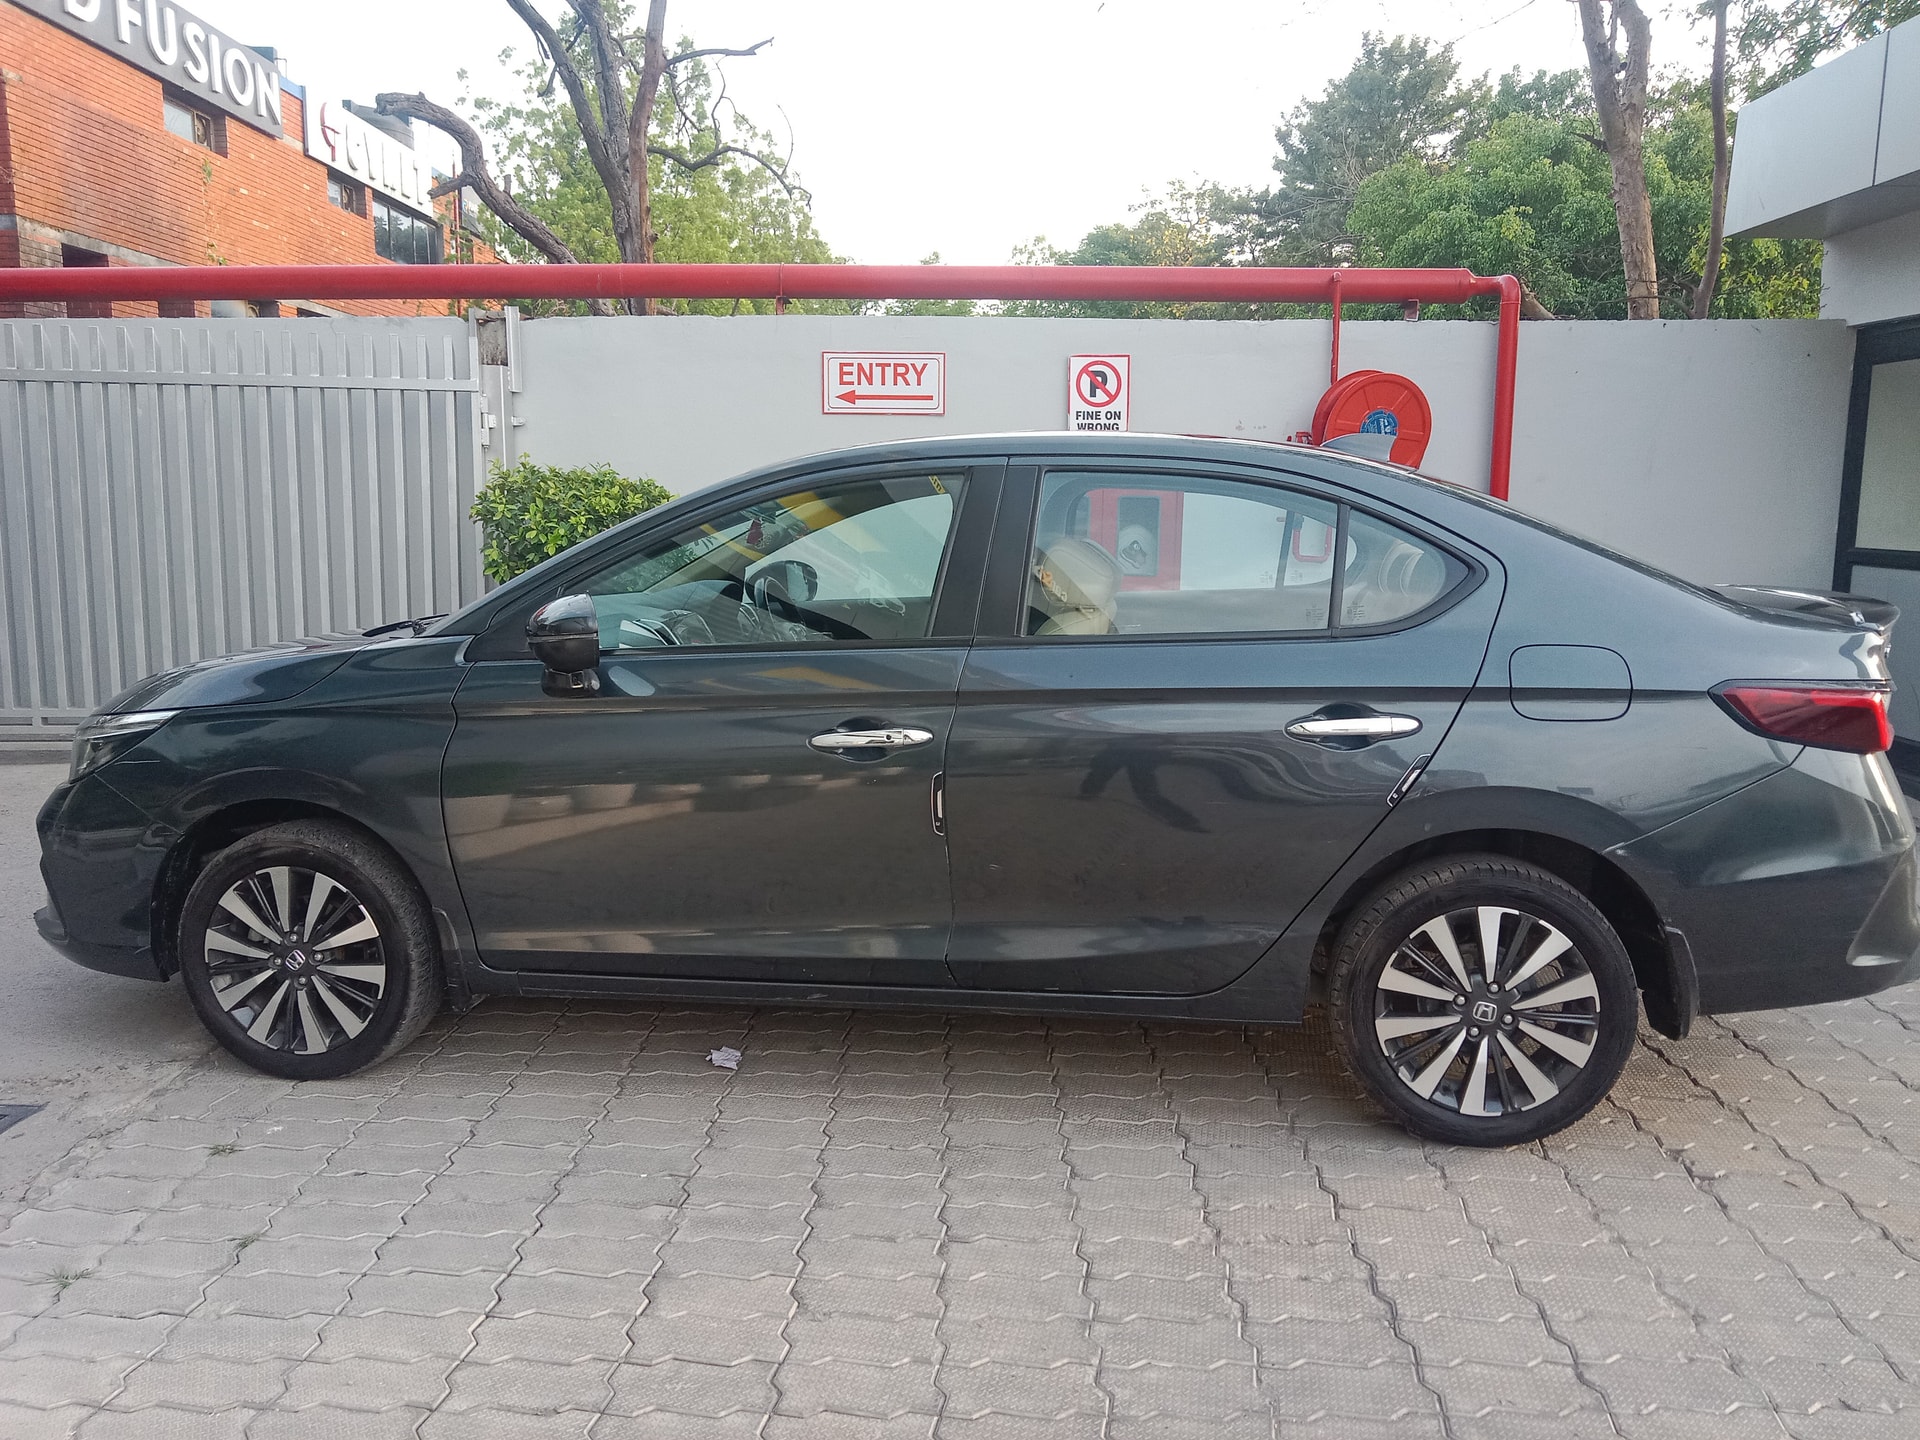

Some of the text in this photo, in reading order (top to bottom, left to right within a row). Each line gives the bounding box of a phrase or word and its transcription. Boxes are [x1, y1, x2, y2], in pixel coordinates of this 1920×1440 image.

[116, 0, 281, 125] FUSION
[838, 362, 929, 387] ENTRY
[1075, 410, 1122, 421] FINE ON
[1077, 422, 1120, 431] WRONG
